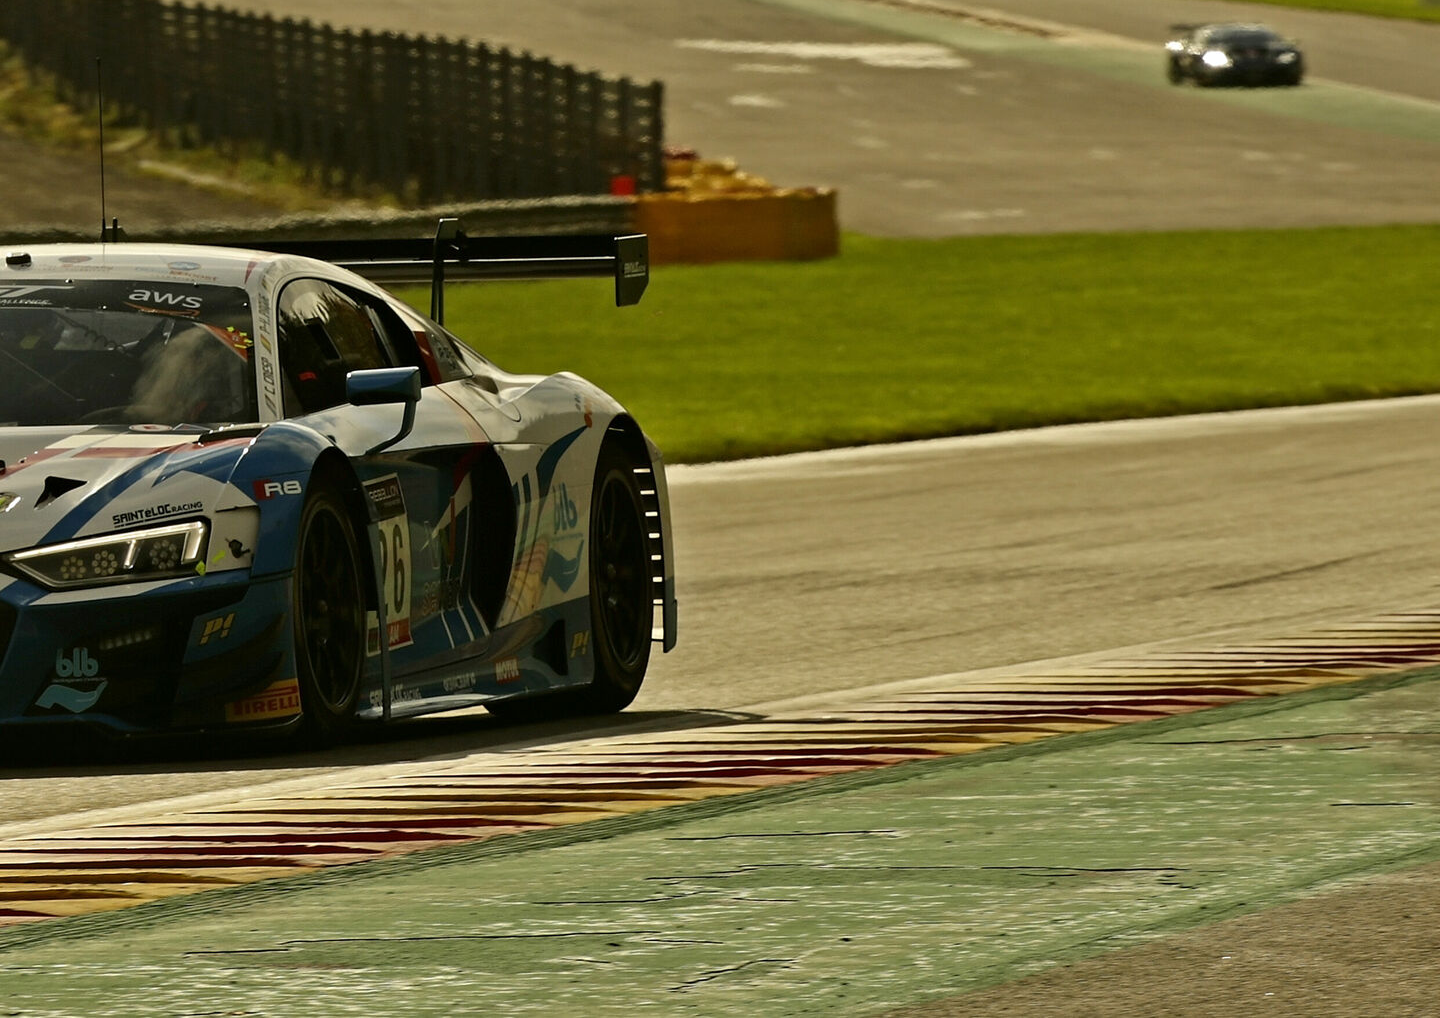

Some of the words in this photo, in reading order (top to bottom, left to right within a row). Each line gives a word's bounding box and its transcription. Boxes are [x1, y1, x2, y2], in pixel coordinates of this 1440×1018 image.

[128, 289, 203, 309] aws
[263, 480, 302, 497] R8
[56, 647, 99, 678] blb
